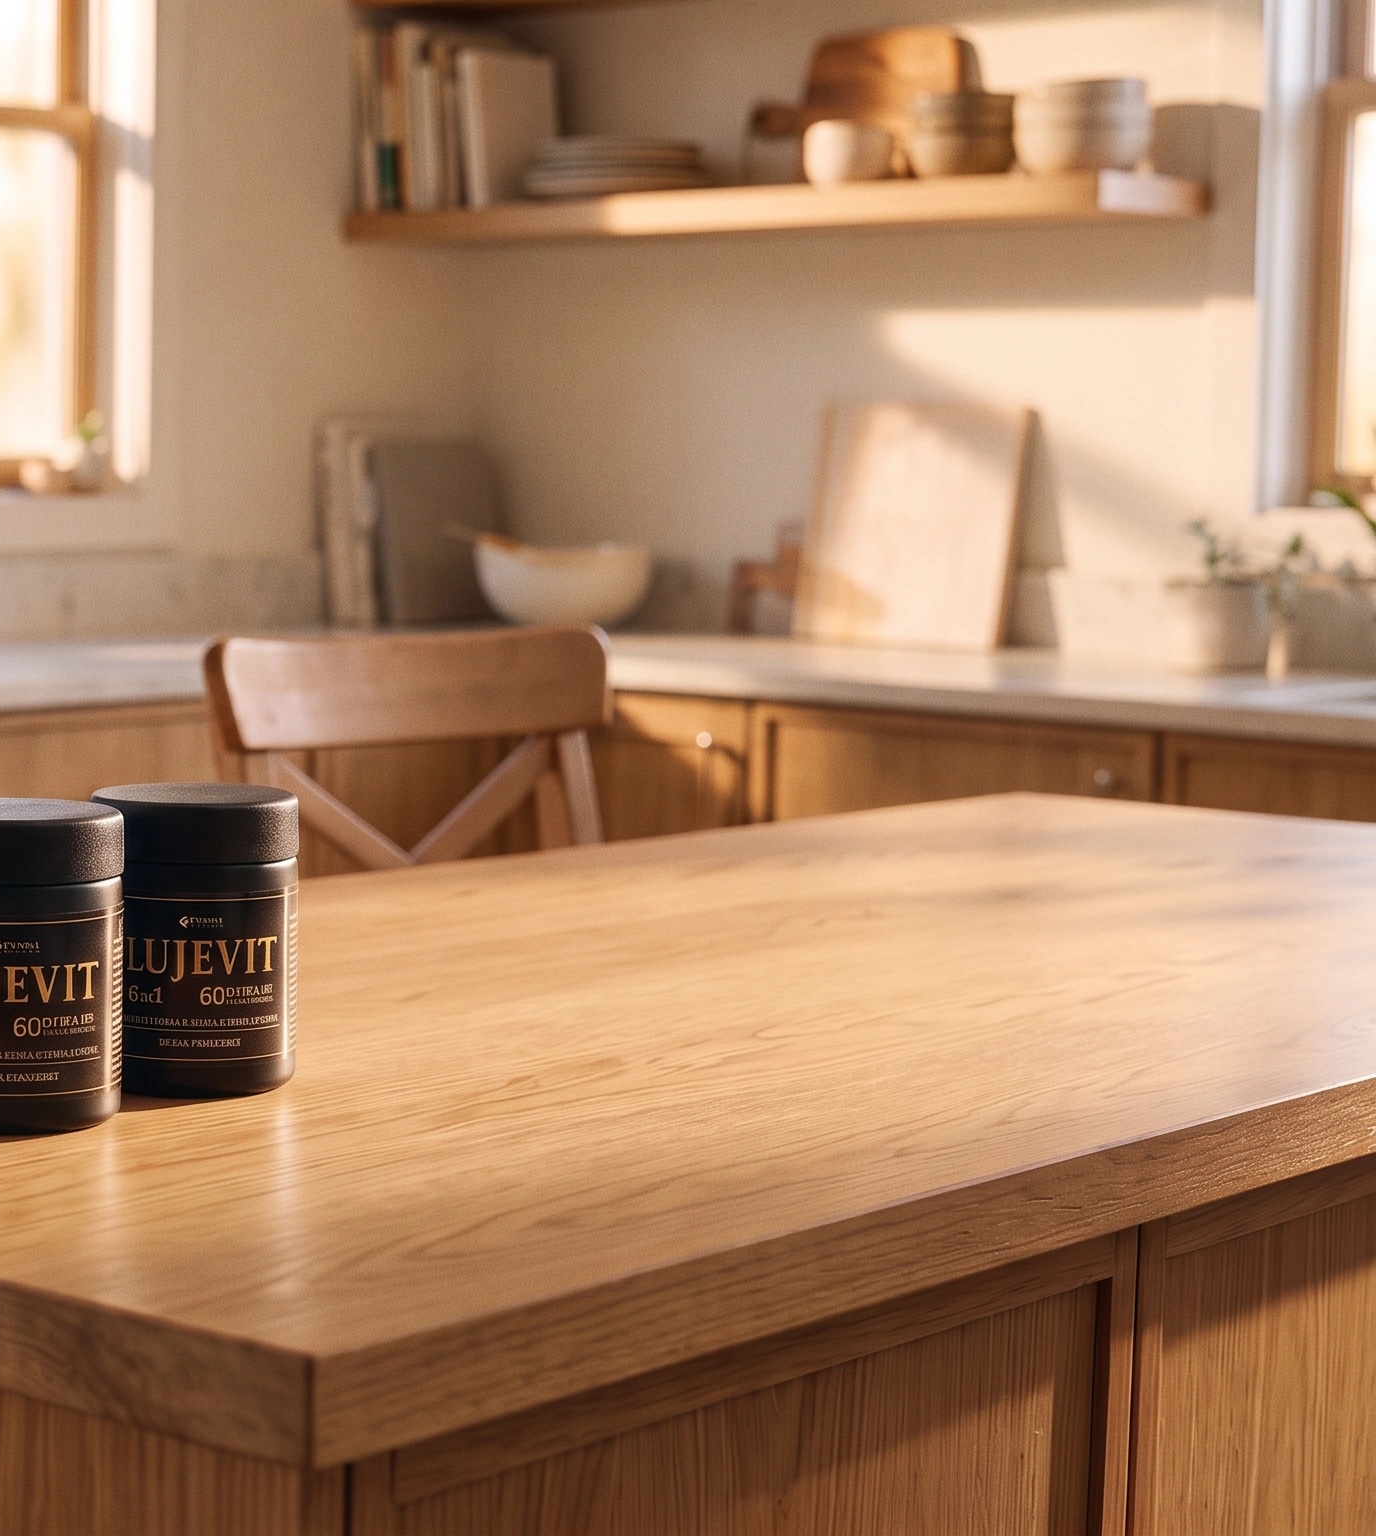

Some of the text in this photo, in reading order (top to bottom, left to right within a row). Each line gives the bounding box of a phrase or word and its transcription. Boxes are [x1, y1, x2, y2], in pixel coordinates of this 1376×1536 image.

[126, 935, 278, 983] LUJEVIT
[199, 986, 225, 1006] 60
[13, 1016, 41, 1038] 60
